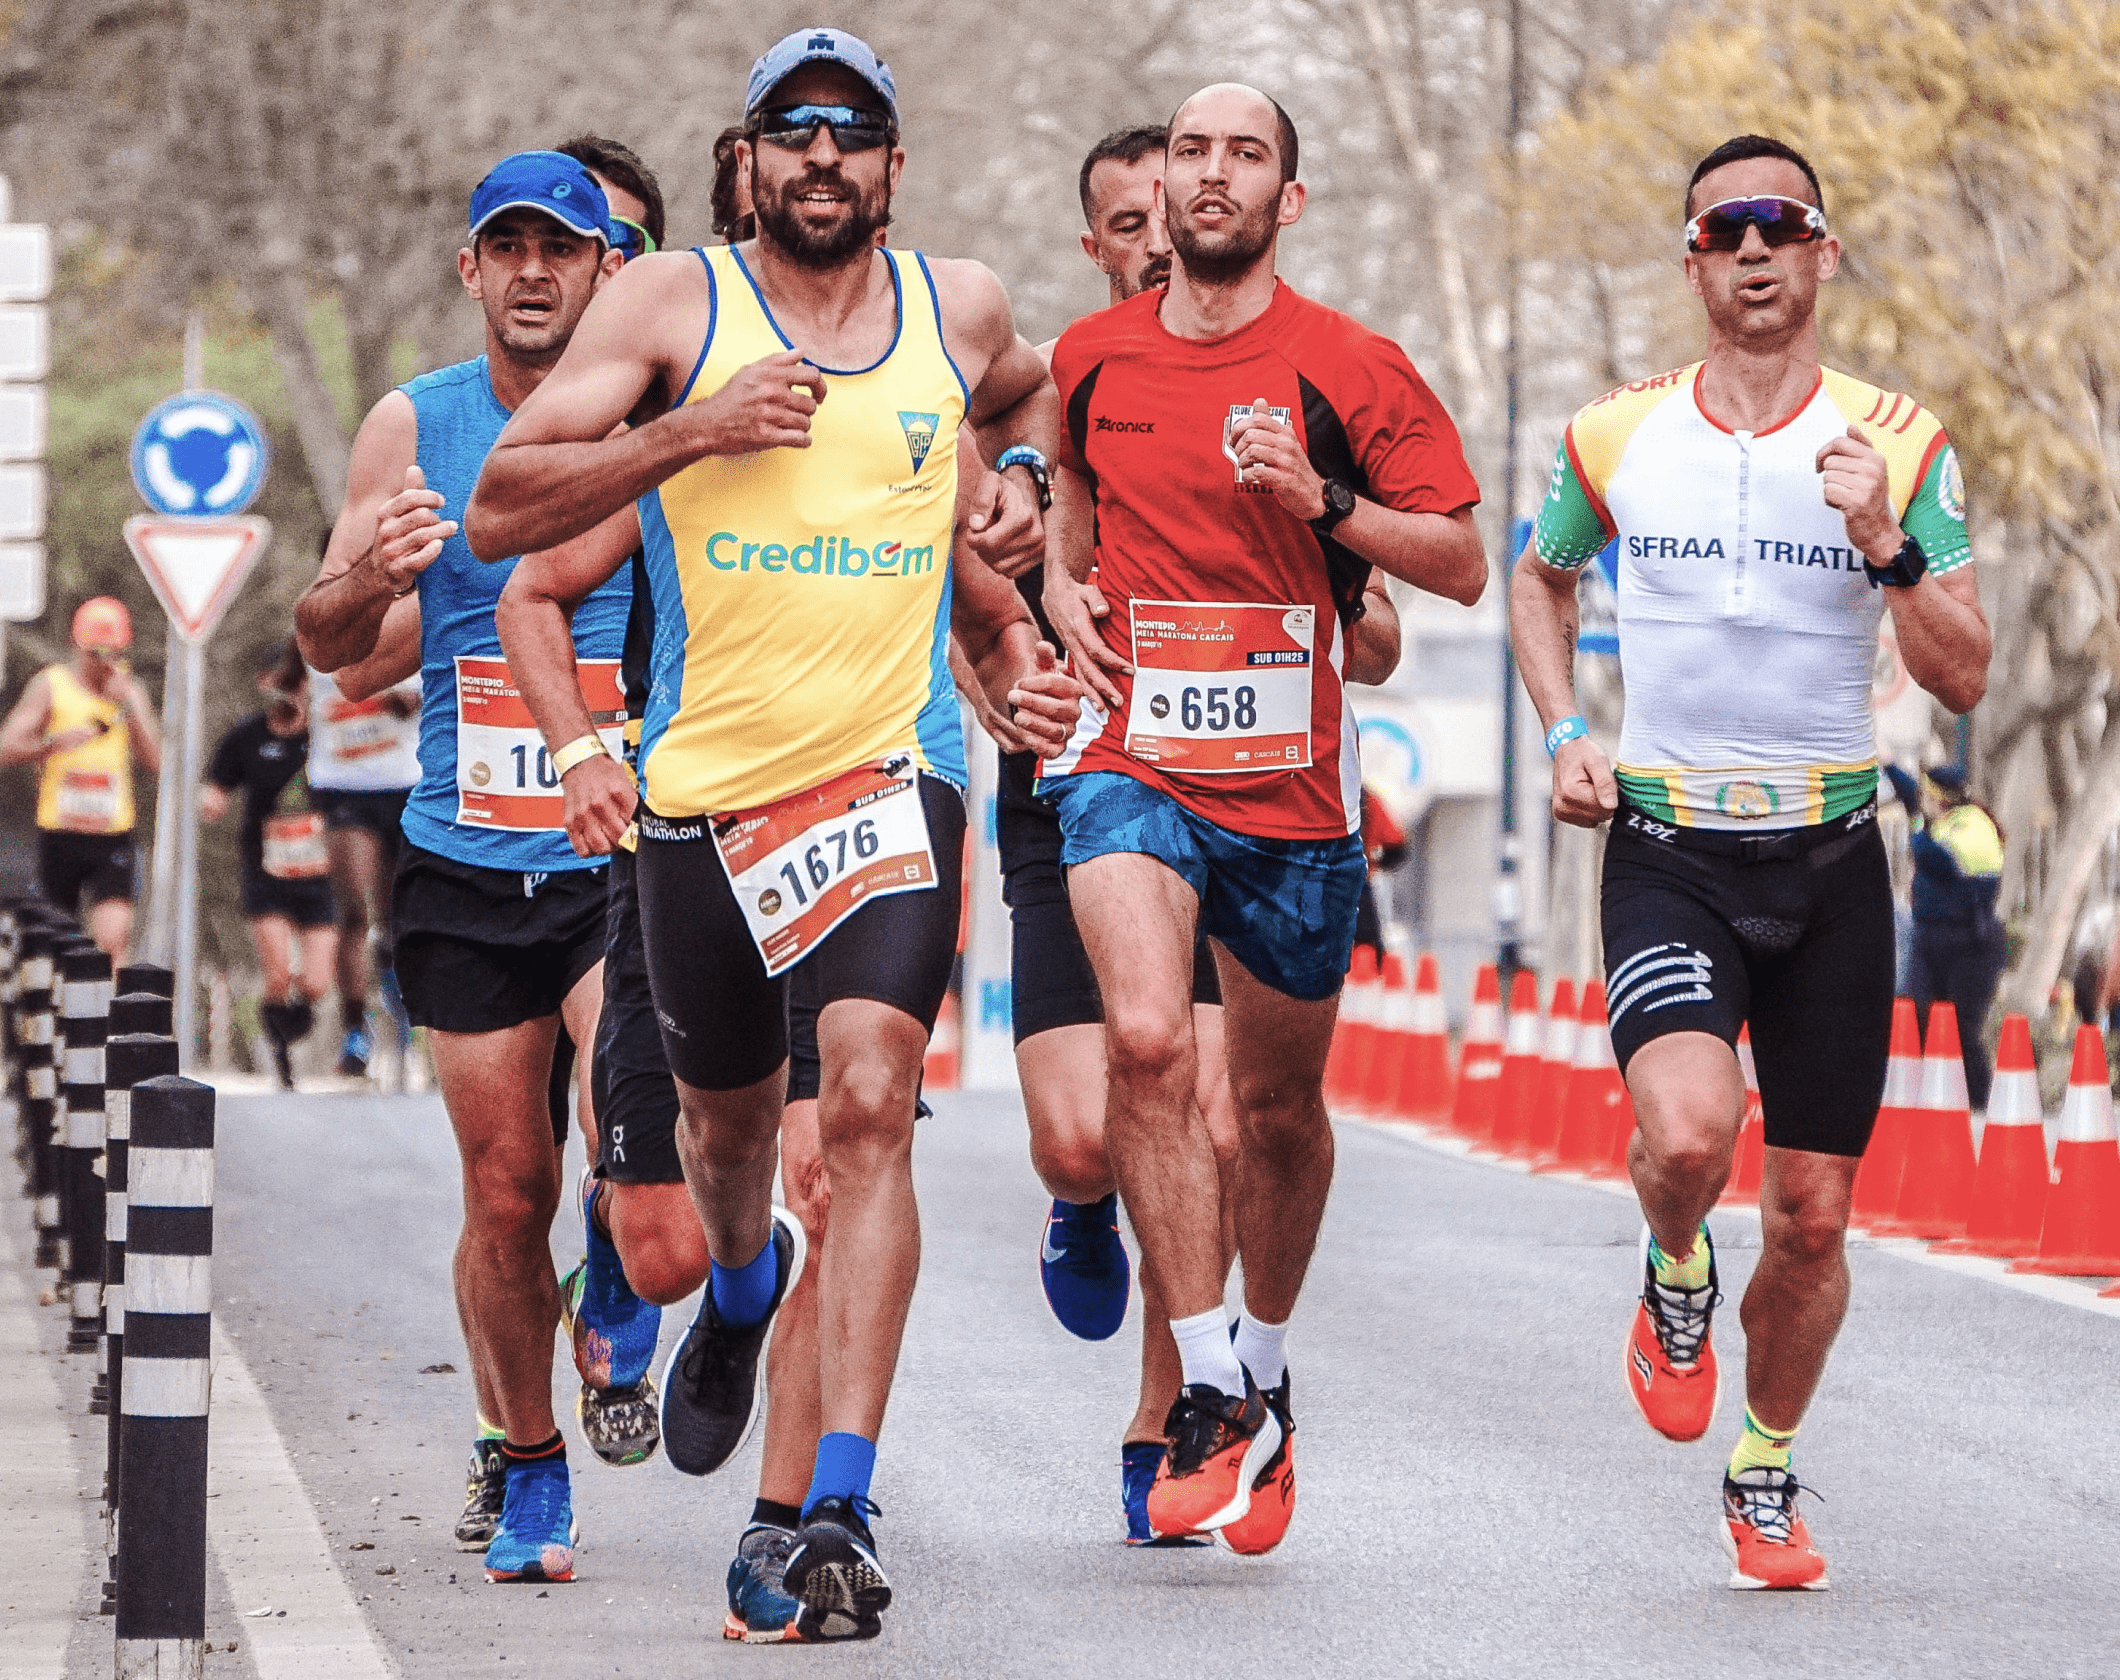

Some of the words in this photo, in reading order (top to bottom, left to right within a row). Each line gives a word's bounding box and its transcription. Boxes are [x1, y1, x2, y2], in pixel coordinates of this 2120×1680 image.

[706, 532, 934, 577] Credibom
[1629, 536, 1726, 559] SFRAA
[1135, 620, 1177, 631] MONTEPIO
[1136, 630, 1155, 638] MEIA
[1157, 632, 1197, 641] MARATONA
[1199, 633, 1234, 642] CASCAIS
[1253, 652, 1273, 664] SUB
[1274, 652, 1304, 664] 01H25
[461, 675, 504, 688] MONTEPIO
[1181, 686, 1257, 732] 658
[642, 824, 702, 841] TRIATHLON
[779, 819, 879, 907] 1676
